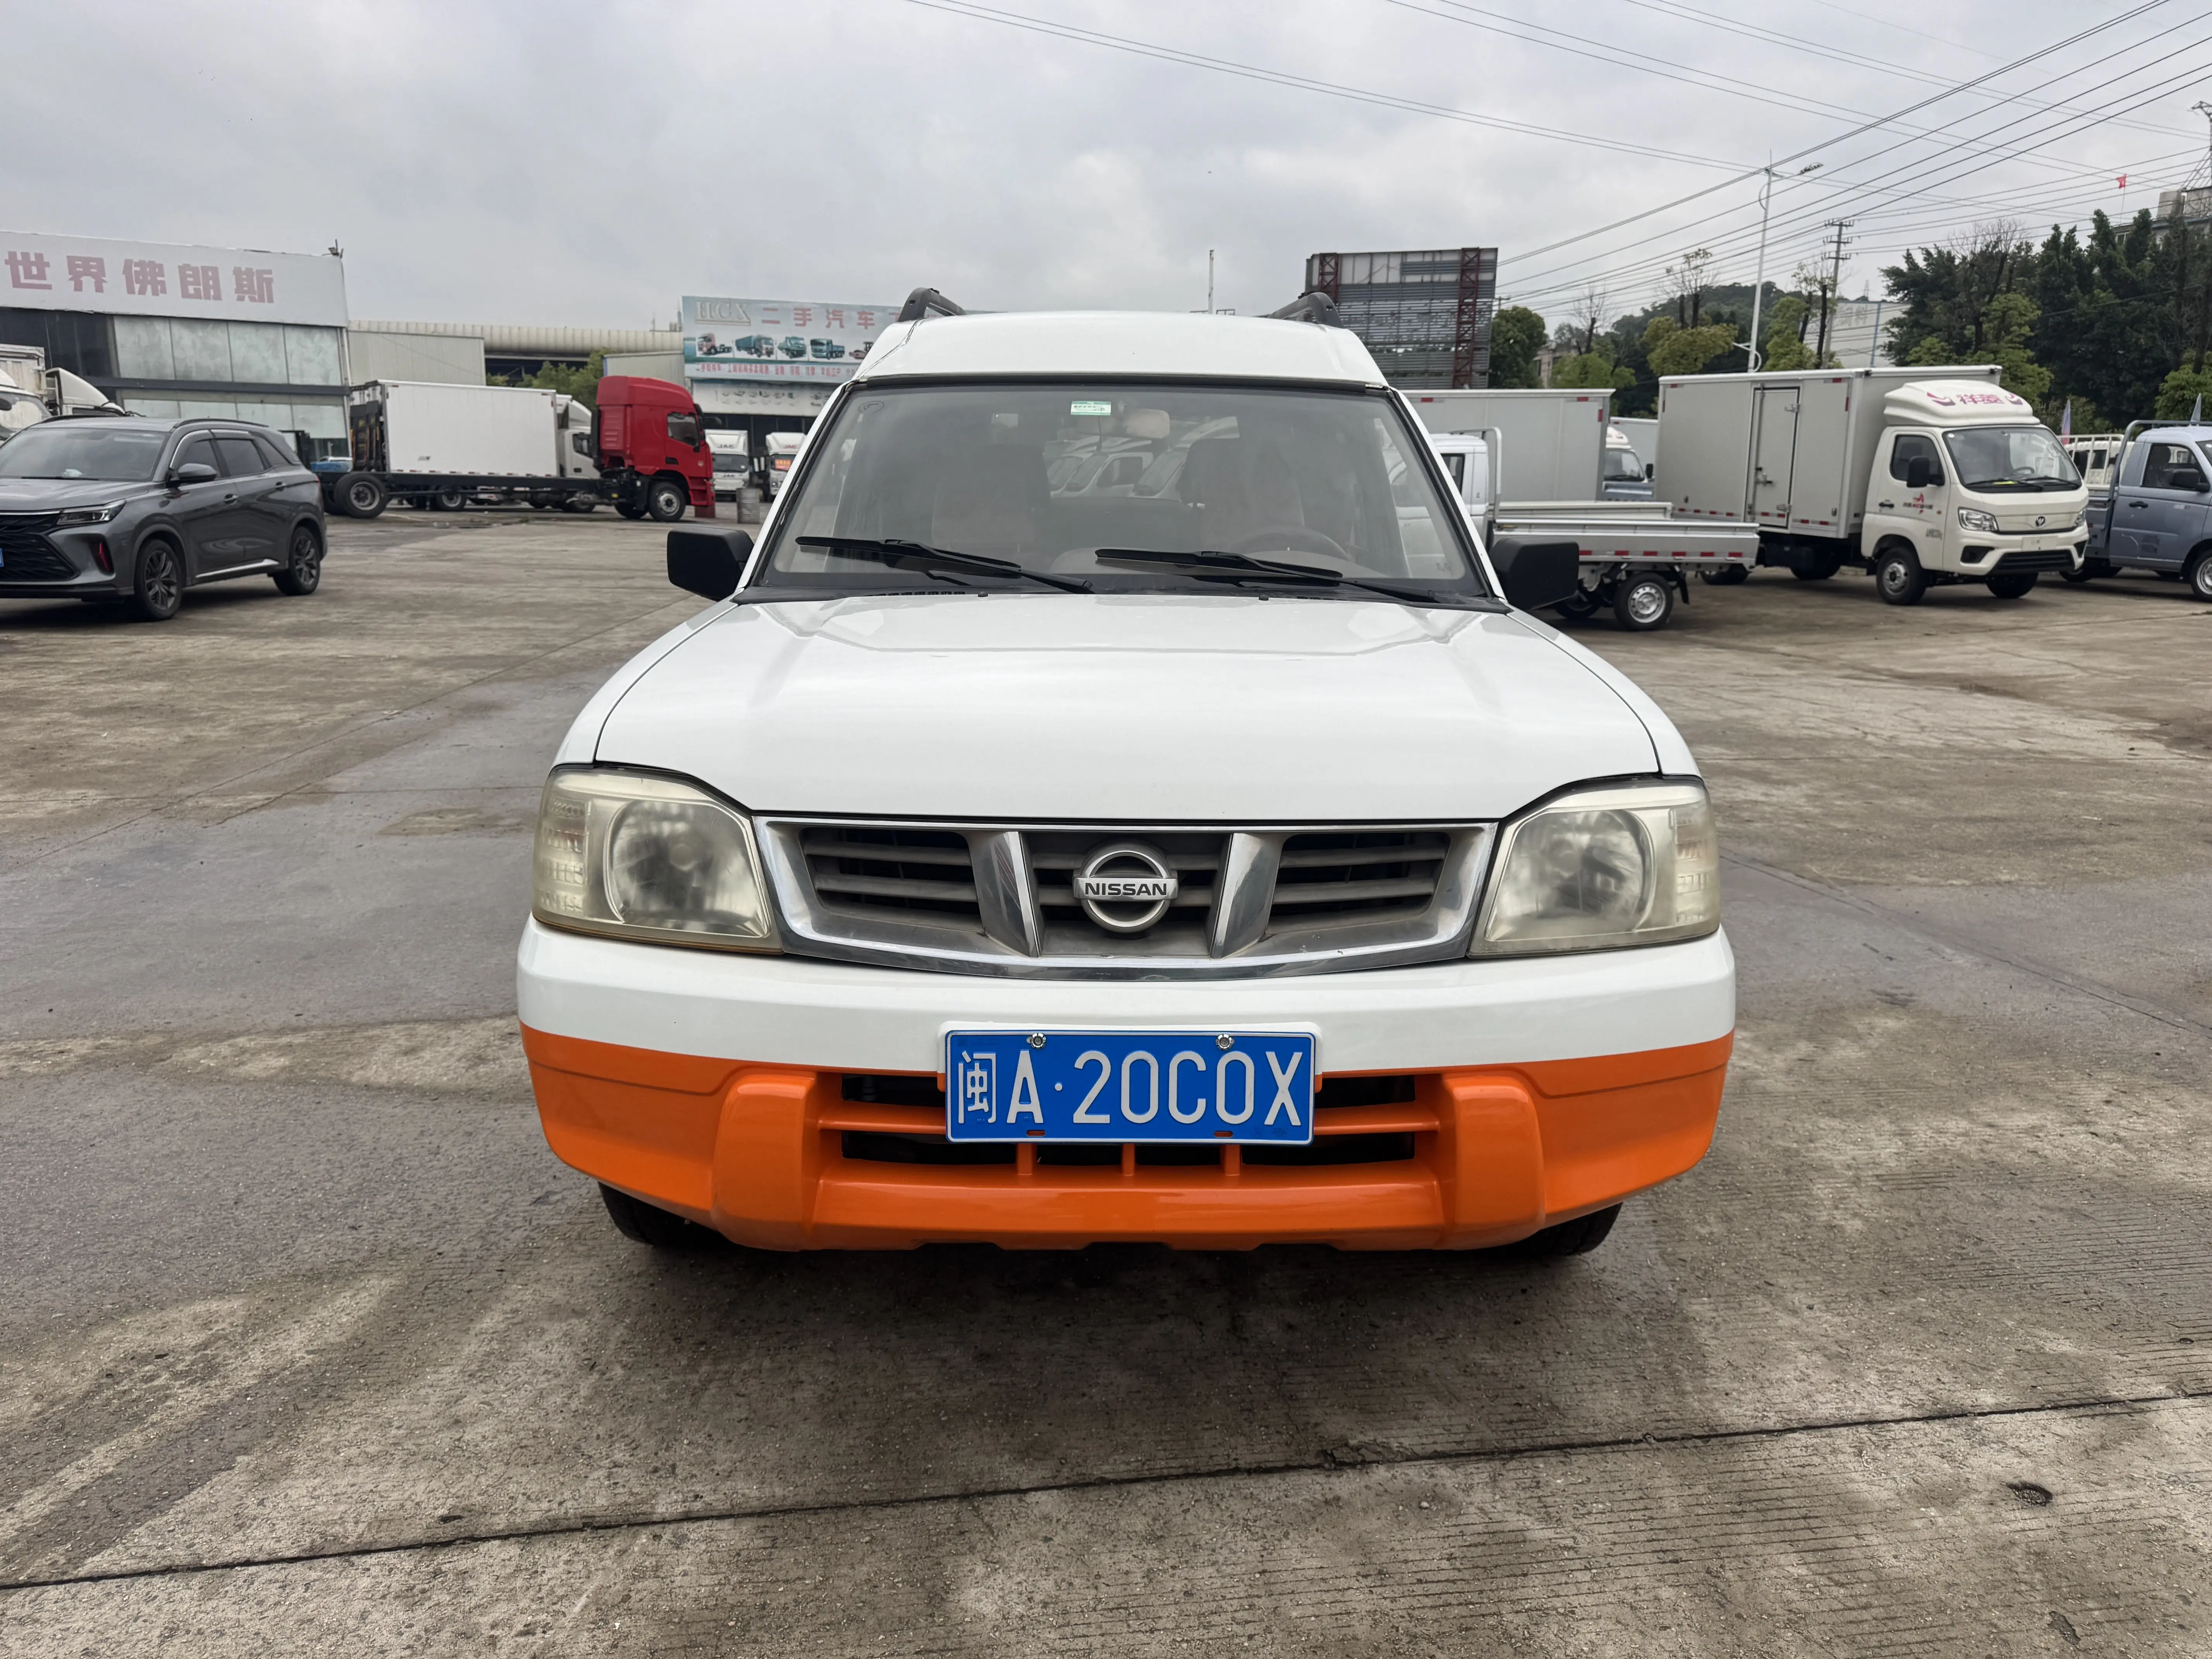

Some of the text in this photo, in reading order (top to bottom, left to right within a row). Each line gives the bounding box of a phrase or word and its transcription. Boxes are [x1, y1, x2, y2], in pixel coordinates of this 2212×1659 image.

[5, 251, 274, 303] 世界佛朗斯
[1085, 883, 1167, 896] NISSAN
